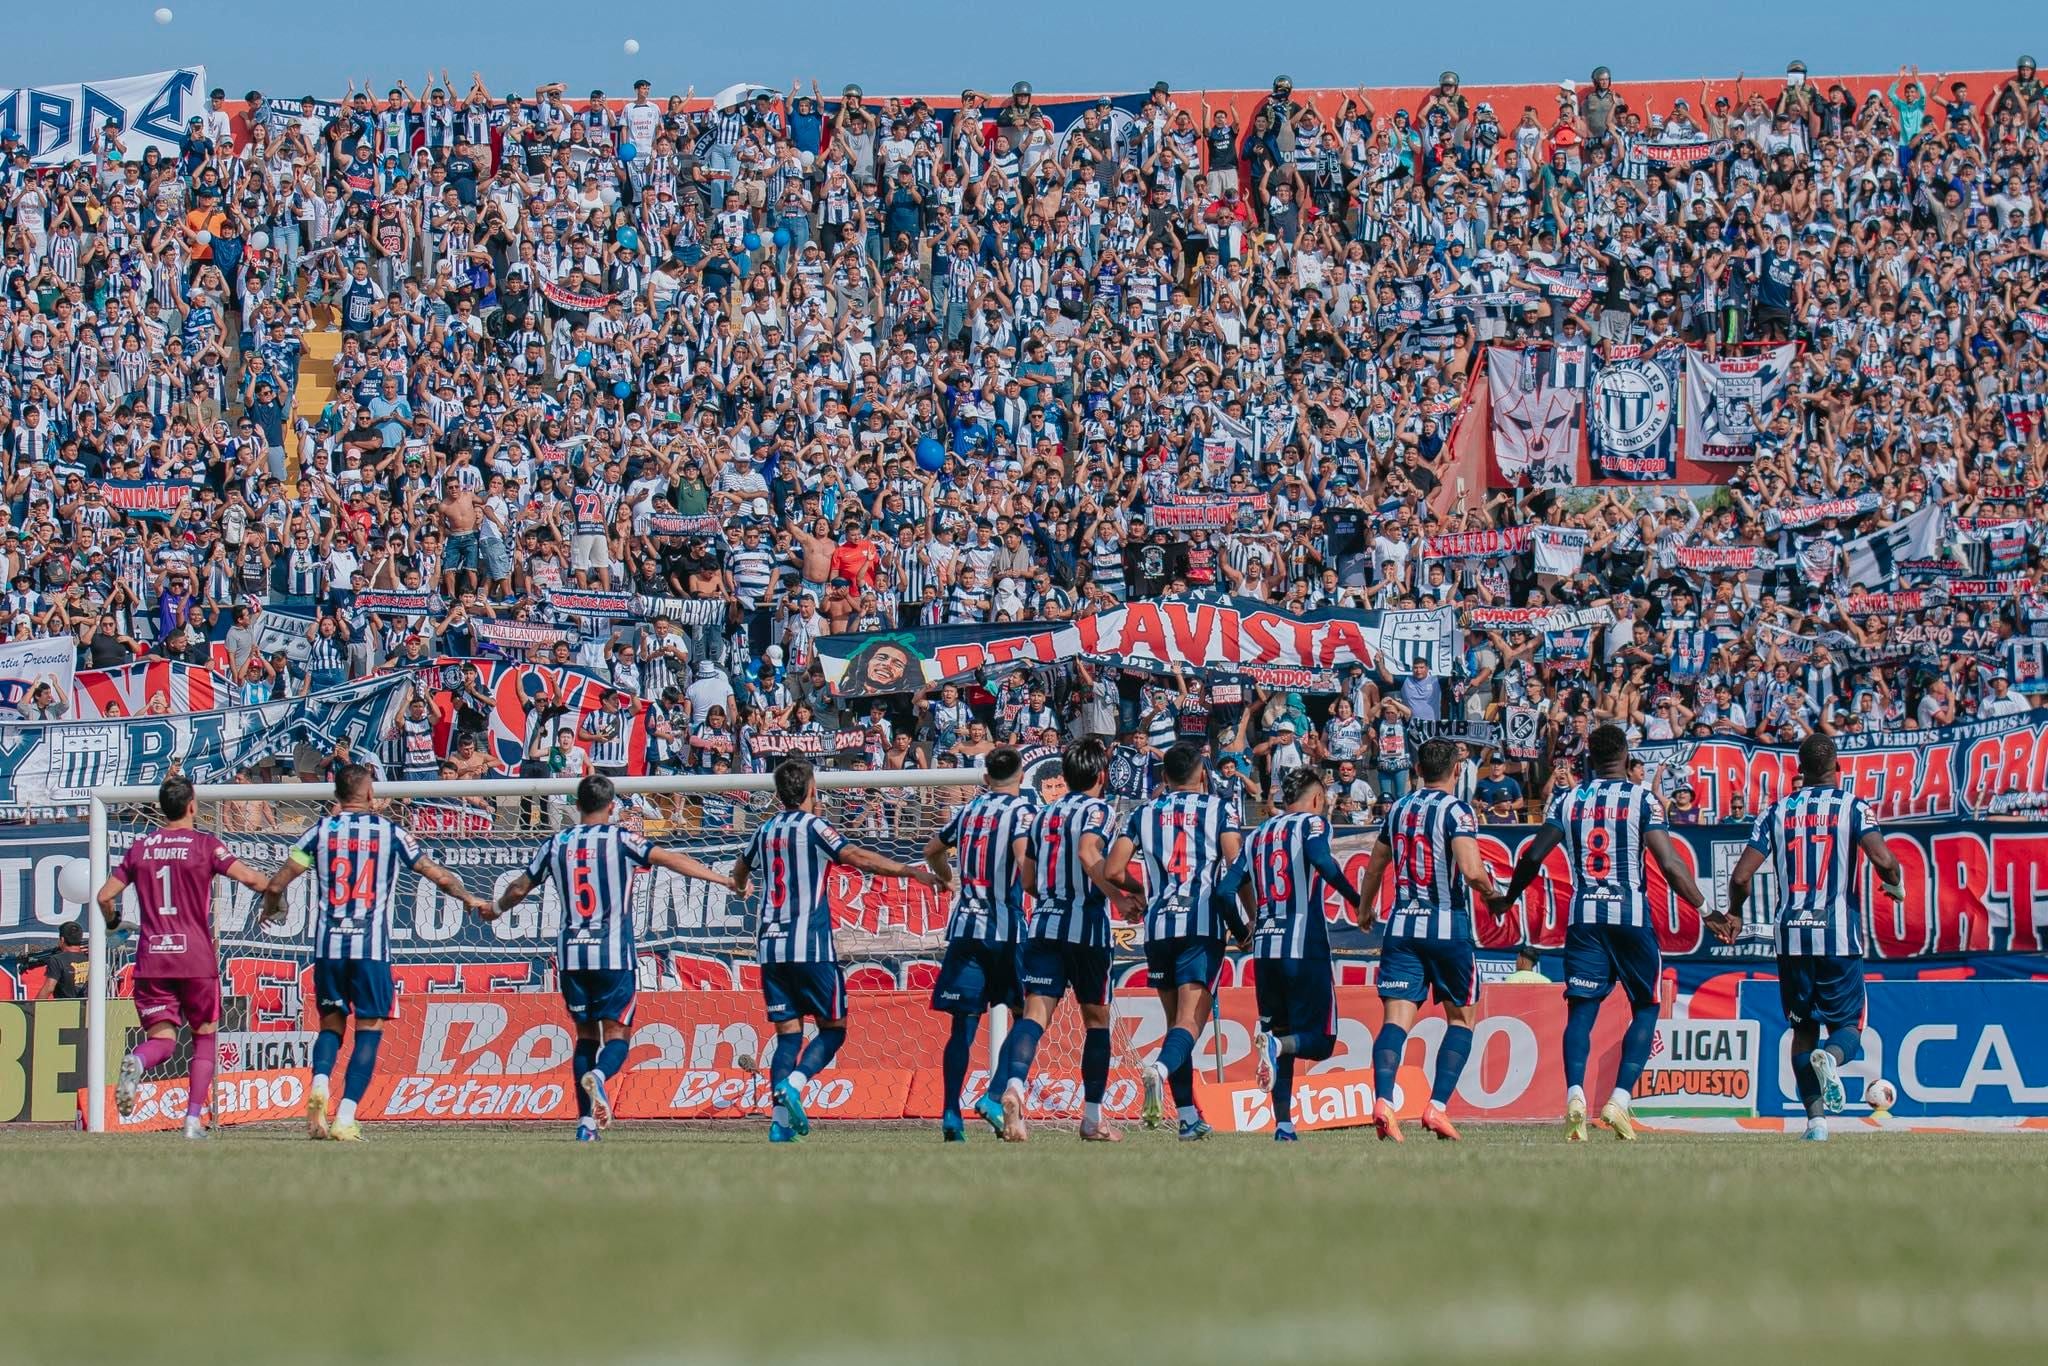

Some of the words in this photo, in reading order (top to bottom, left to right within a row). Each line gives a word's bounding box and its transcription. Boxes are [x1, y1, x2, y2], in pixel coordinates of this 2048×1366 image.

[381, 236, 400, 251] 23
[1615, 435, 1644, 447] CONO
[1643, 417, 1663, 438] SVR
[575, 493, 602, 522] 22
[1153, 505, 1204, 528] FRONTERA
[1780, 508, 1799, 523] LOS
[1801, 499, 1857, 520] INTOCABLES
[1957, 518, 1973, 530] EL
[1541, 532, 1584, 548] MALACOS
[1676, 546, 1723, 569] COWBOYS
[1724, 547, 1755, 569] GRONE
[264, 615, 307, 634] ALIAN
[1549, 614, 1579, 630] MALA
[0, 658, 20, 670] rtin
[23, 652, 71, 667] Presentes
[1441, 634, 1451, 669] LIMA
[59, 727, 113, 737] ALIANZA
[750, 734, 822, 754] BELLAVISTA
[835, 730, 865, 750] 2009
[1834, 733, 1868, 752] VAS
[1871, 729, 1939, 748] VERDES
[1952, 717, 2019, 742] TVMBES
[107, 746, 118, 774] LIMA
[1019, 744, 1060, 768] ACINTO
[1571, 806, 1580, 821] E.
[1580, 805, 1629, 821] CASTILLO
[1784, 814, 1839, 830] ADVINCULA
[143, 849, 153, 860] A.
[153, 847, 189, 861] DUARTE
[327, 837, 379, 853] GUERRERO
[1168, 831, 1191, 884] 4
[1585, 827, 1611, 881] 8
[960, 833, 992, 888] 11
[1044, 833, 1062, 889] 7
[1393, 832, 1434, 888] 20
[1787, 834, 1835, 894] 17
[155, 864, 178, 916] 1
[329, 856, 376, 910] 34
[573, 865, 597, 919] 5
[769, 856, 787, 909] 3
[1254, 848, 1293, 908] 13
[1477, 961, 1515, 973] ALIAN
[245, 1041, 292, 1070] LIGA
[1670, 1029, 1730, 1061] LIGA
[1735, 1030, 1748, 1061] 1
[384, 1077, 564, 1117] Betano
[1653, 1069, 1750, 1100] APUESTO
